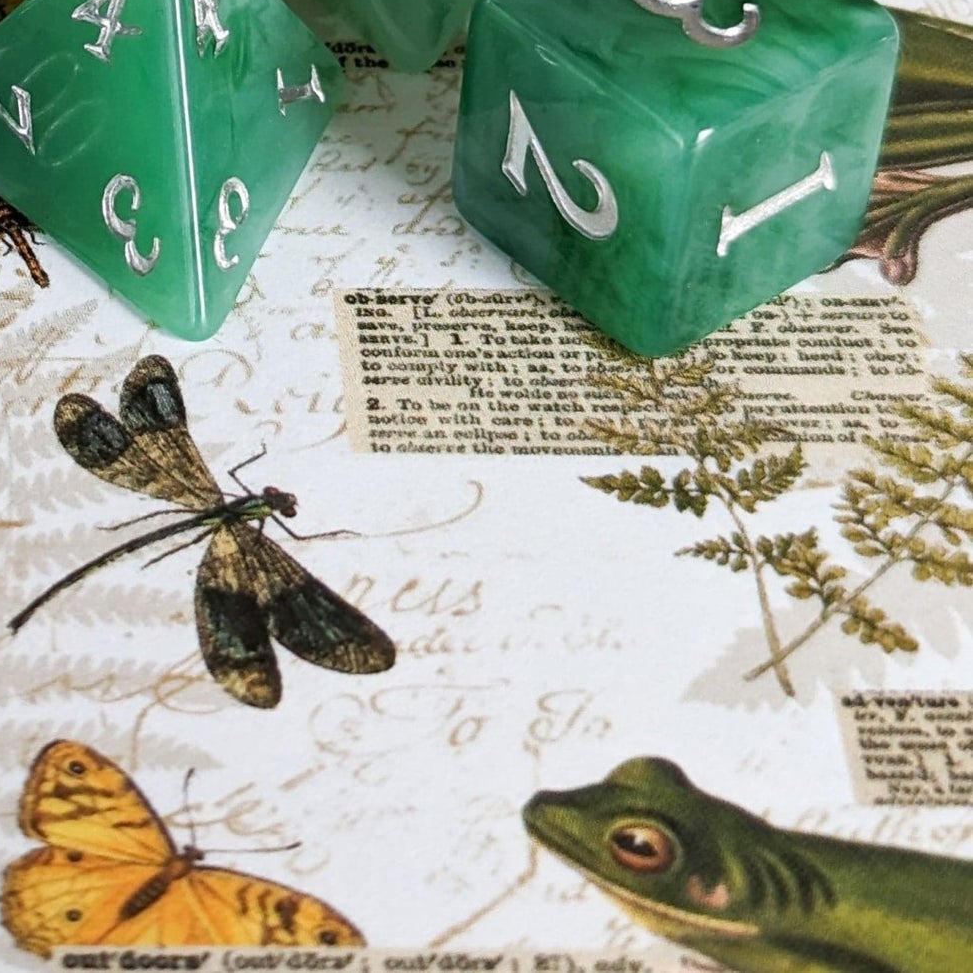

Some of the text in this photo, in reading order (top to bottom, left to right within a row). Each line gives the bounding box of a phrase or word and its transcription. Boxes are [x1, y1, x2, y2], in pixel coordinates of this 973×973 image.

[276, 63, 325, 117] 1
[502, 89, 620, 242] 2
[716, 150, 838, 258] 1
[102, 173, 162, 277] 3
[214, 175, 252, 270] 3
[396, 398, 422, 410] To
[488, 400, 520, 412] the
[528, 401, 585, 412] watch
